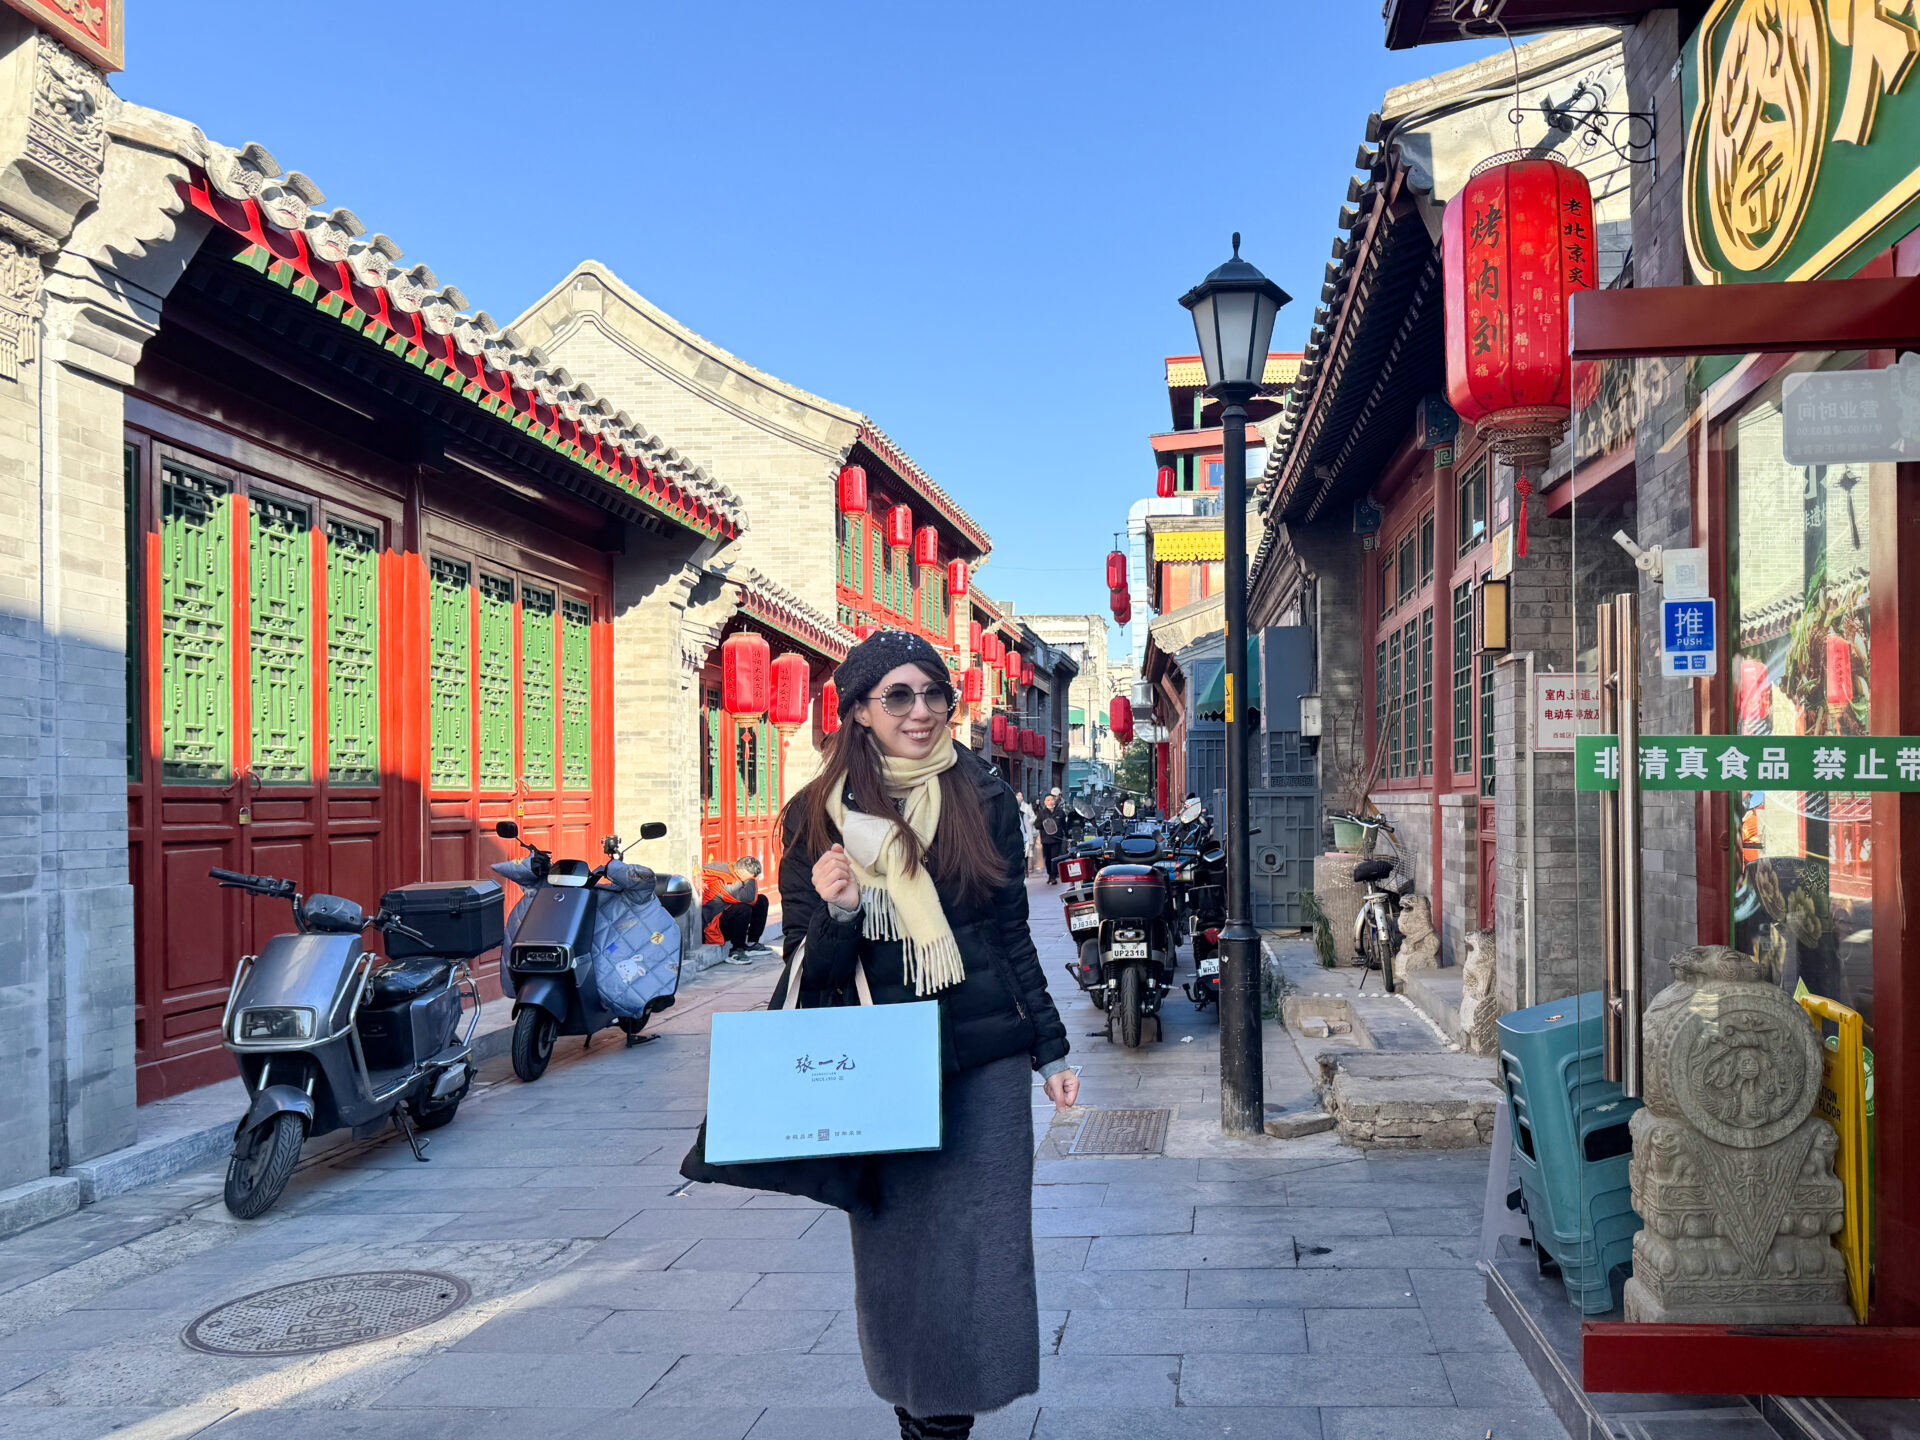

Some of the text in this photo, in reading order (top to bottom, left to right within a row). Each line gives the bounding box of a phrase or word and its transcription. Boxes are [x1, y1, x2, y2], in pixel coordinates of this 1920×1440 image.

[1562, 197, 1592, 288] 老北京炙
[1469, 204, 1504, 357] 烤肉刘
[1674, 607, 1705, 638] 推
[1676, 638, 1703, 646] PUSH
[1552, 731, 1574, 739] 西城区
[1593, 744, 1920, 782] 非清真食品 禁止带
[1114, 949, 1145, 958] UP2318
[1818, 1097, 1841, 1121] FLOOR
